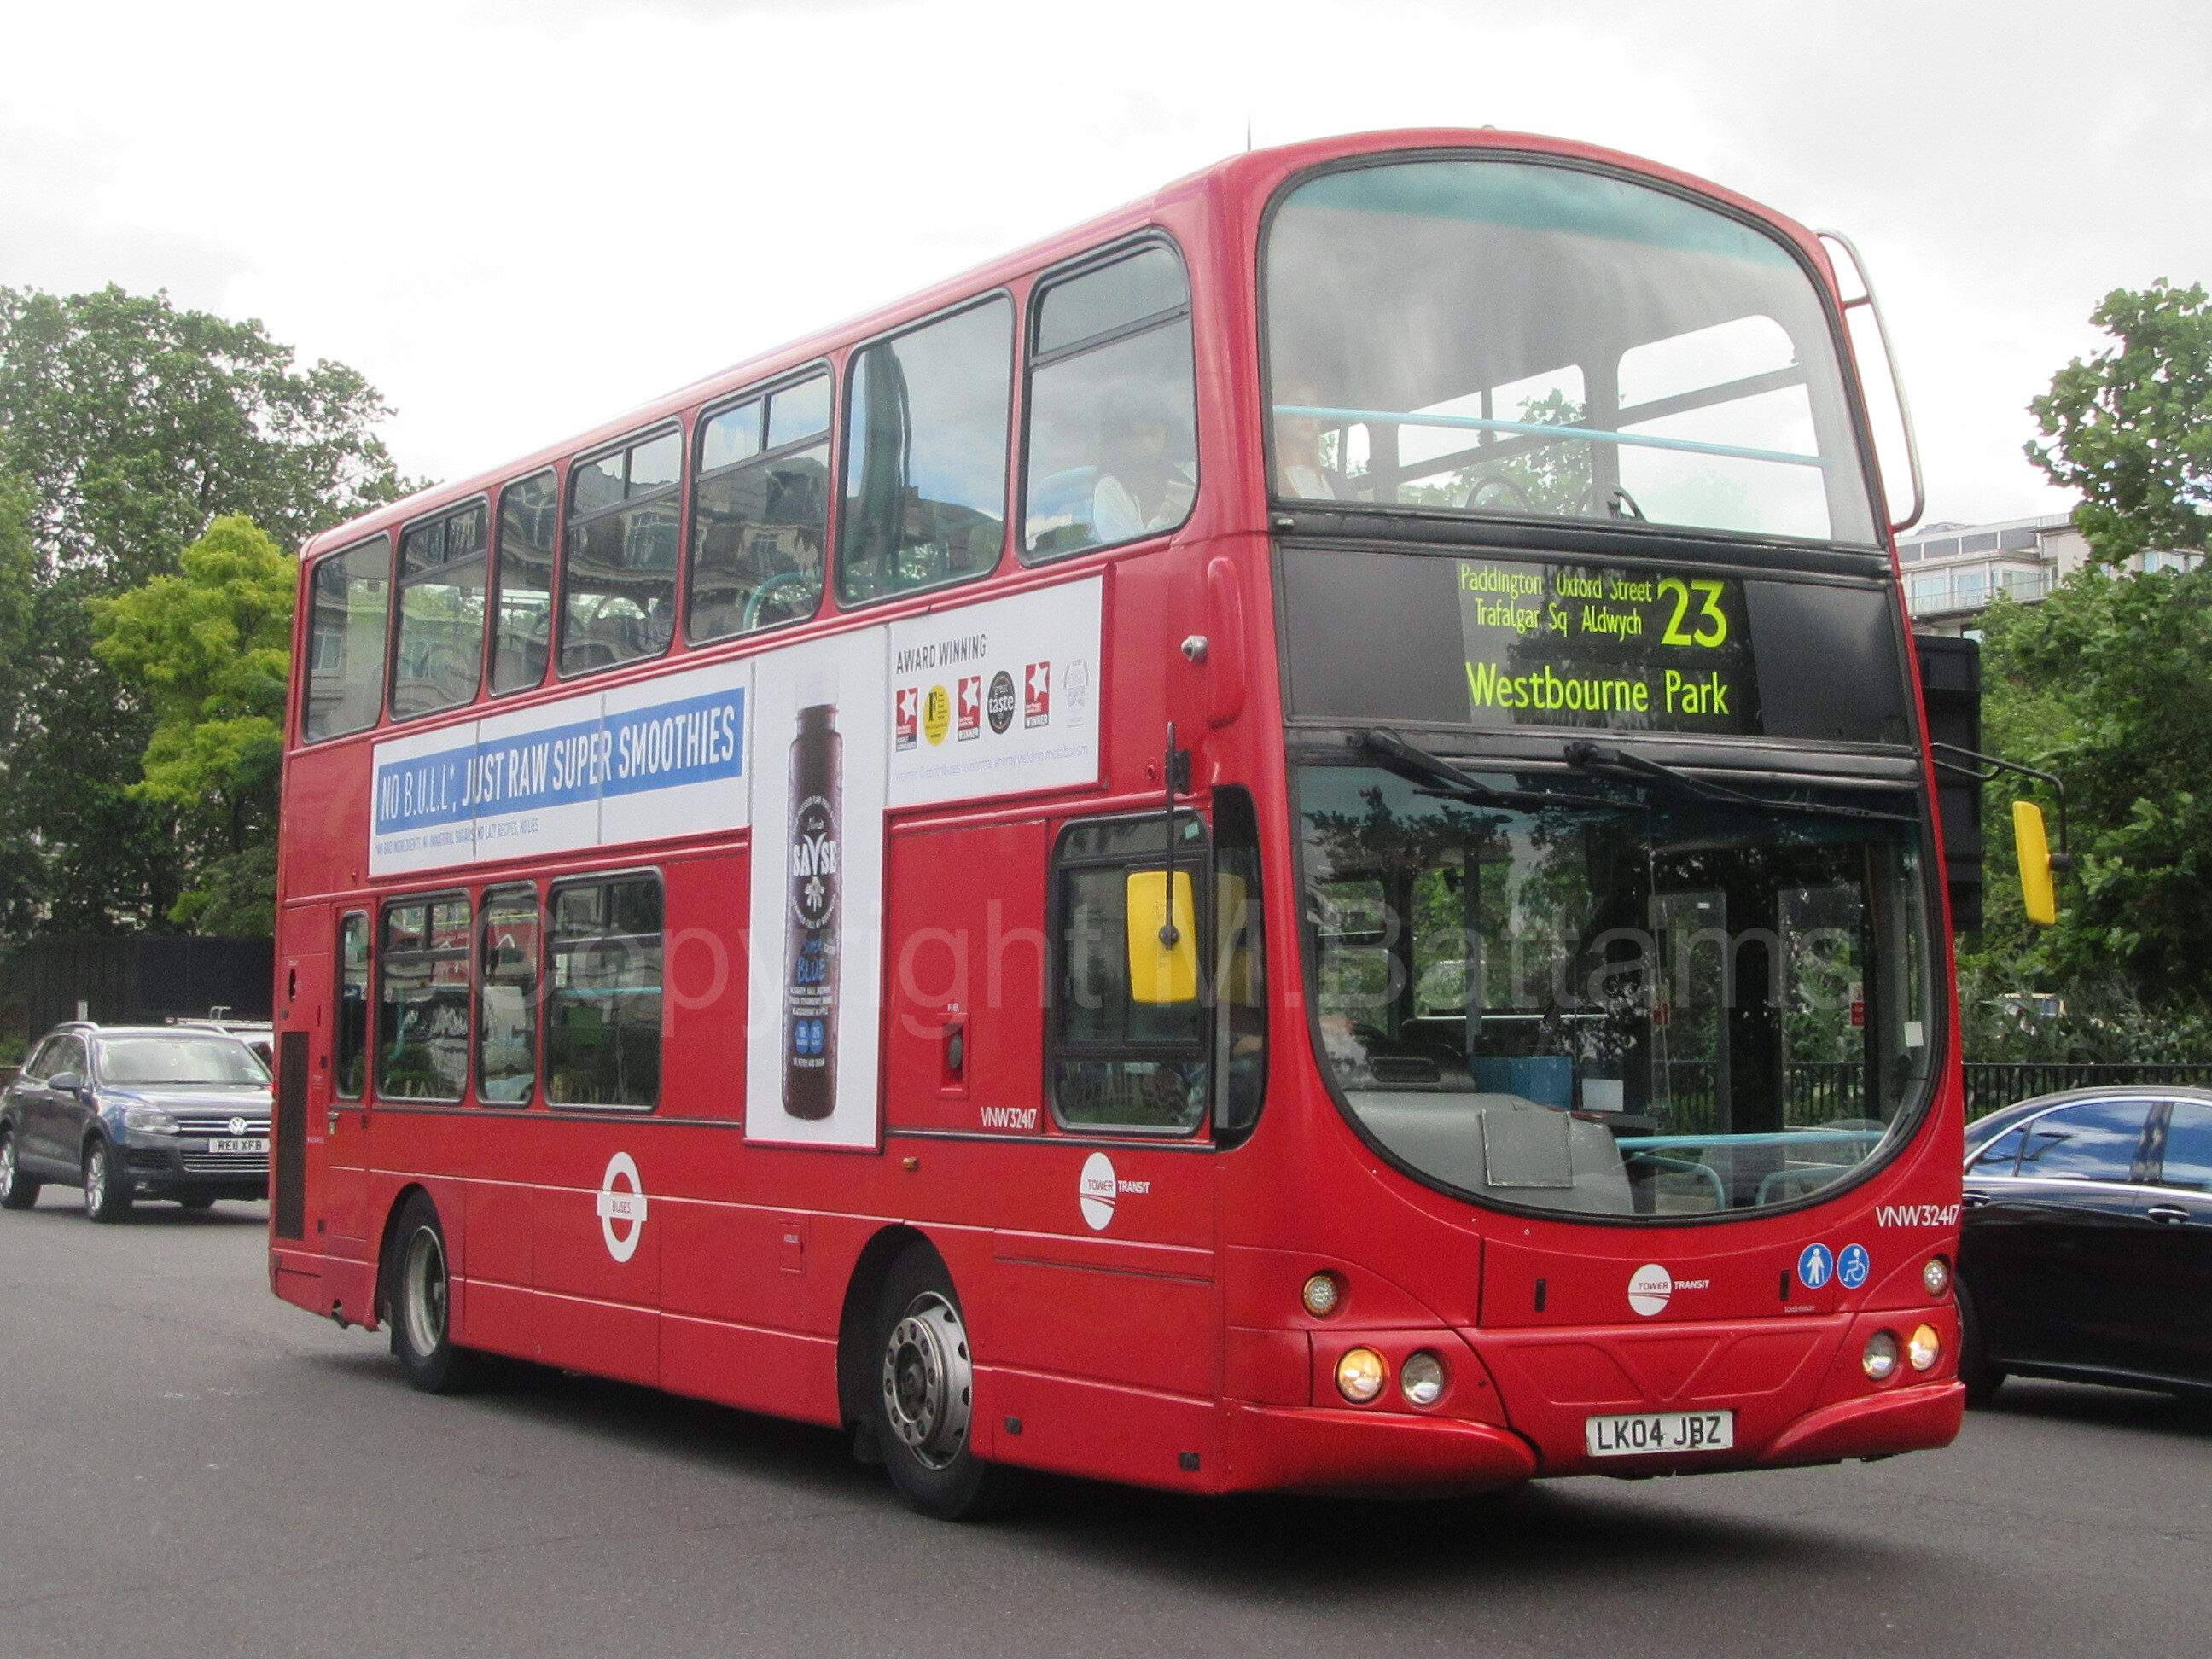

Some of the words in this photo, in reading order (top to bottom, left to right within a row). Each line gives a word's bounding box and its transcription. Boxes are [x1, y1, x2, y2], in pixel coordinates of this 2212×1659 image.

[1461, 563, 1543, 599] Paddington
[1556, 571, 1603, 599] Oxford
[1610, 573, 1653, 602] Street
[1475, 598, 1540, 634] Trafalgar
[1548, 602, 1568, 637] Sq
[1581, 605, 1643, 642] Aldwych
[1657, 578, 1728, 648] 23
[896, 644, 936, 674] AWARD
[939, 633, 987, 666] WINNING
[989, 693, 1014, 714] taste
[1465, 662, 1649, 712] Westbourne
[1665, 670, 1730, 715] Park
[381, 774, 399, 823] NO
[462, 753, 504, 807] JUST
[507, 742, 550, 798] RAW
[553, 731, 612, 792] SUPER
[619, 704, 736, 779] SMOOTHIES
[1045, 743, 1089, 763] metabolism
[797, 956, 826, 984] BLUE
[241, 1139, 263, 1150] XFB
[1087, 1179, 1114, 1191] TOWER
[1117, 1179, 1150, 1194] TRANSIT
[612, 1200, 632, 1214] BUSES
[1638, 1281, 1669, 1291] TOWER
[1674, 1279, 1710, 1290] TRANSIT
[1598, 1417, 1664, 1451] LK04
[1674, 1414, 1721, 1447] JBZ
